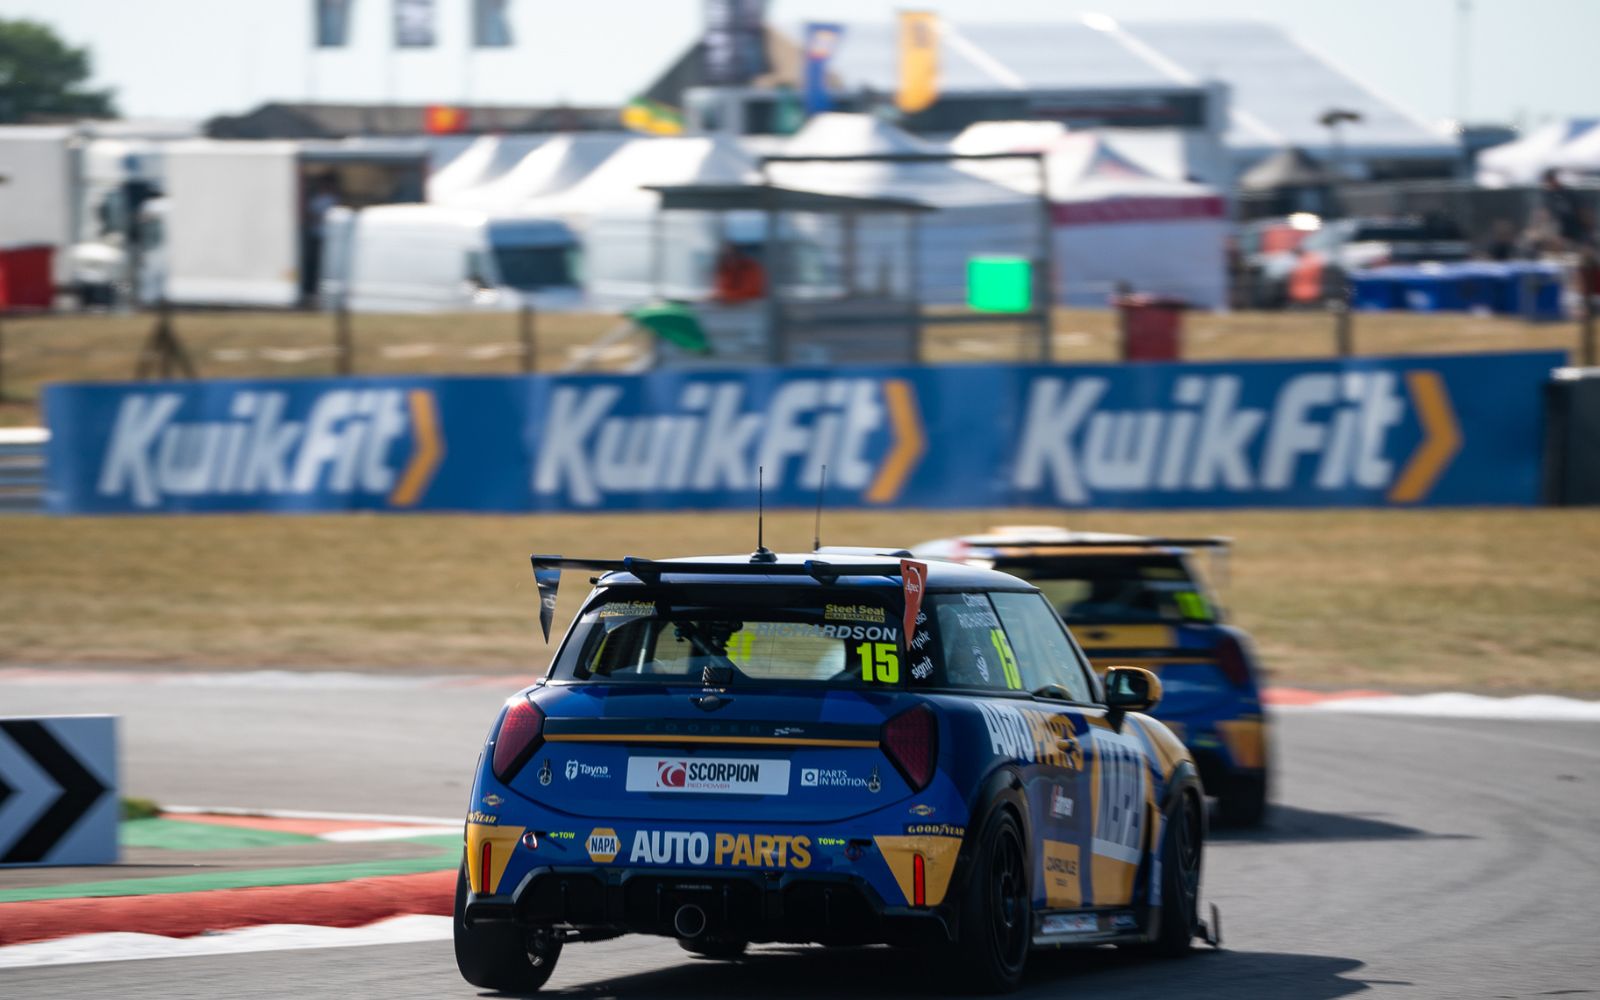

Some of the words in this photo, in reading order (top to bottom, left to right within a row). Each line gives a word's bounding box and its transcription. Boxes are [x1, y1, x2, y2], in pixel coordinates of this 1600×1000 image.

[825, 603, 857, 614] Steel
[858, 605, 885, 616] Seal
[755, 622, 897, 641] RICHARDSON
[856, 642, 899, 683] 15
[974, 701, 1035, 763] AUTO
[580, 764, 608, 777] Tayna
[689, 763, 760, 783] SCORPION
[819, 769, 848, 778] PARTS
[819, 778, 829, 786] IN
[830, 778, 868, 787] MOTION
[591, 837, 616, 853] NAPA
[630, 830, 709, 864] AUTO
[714, 832, 812, 868] PARTS
[817, 837, 835, 845] TOW
